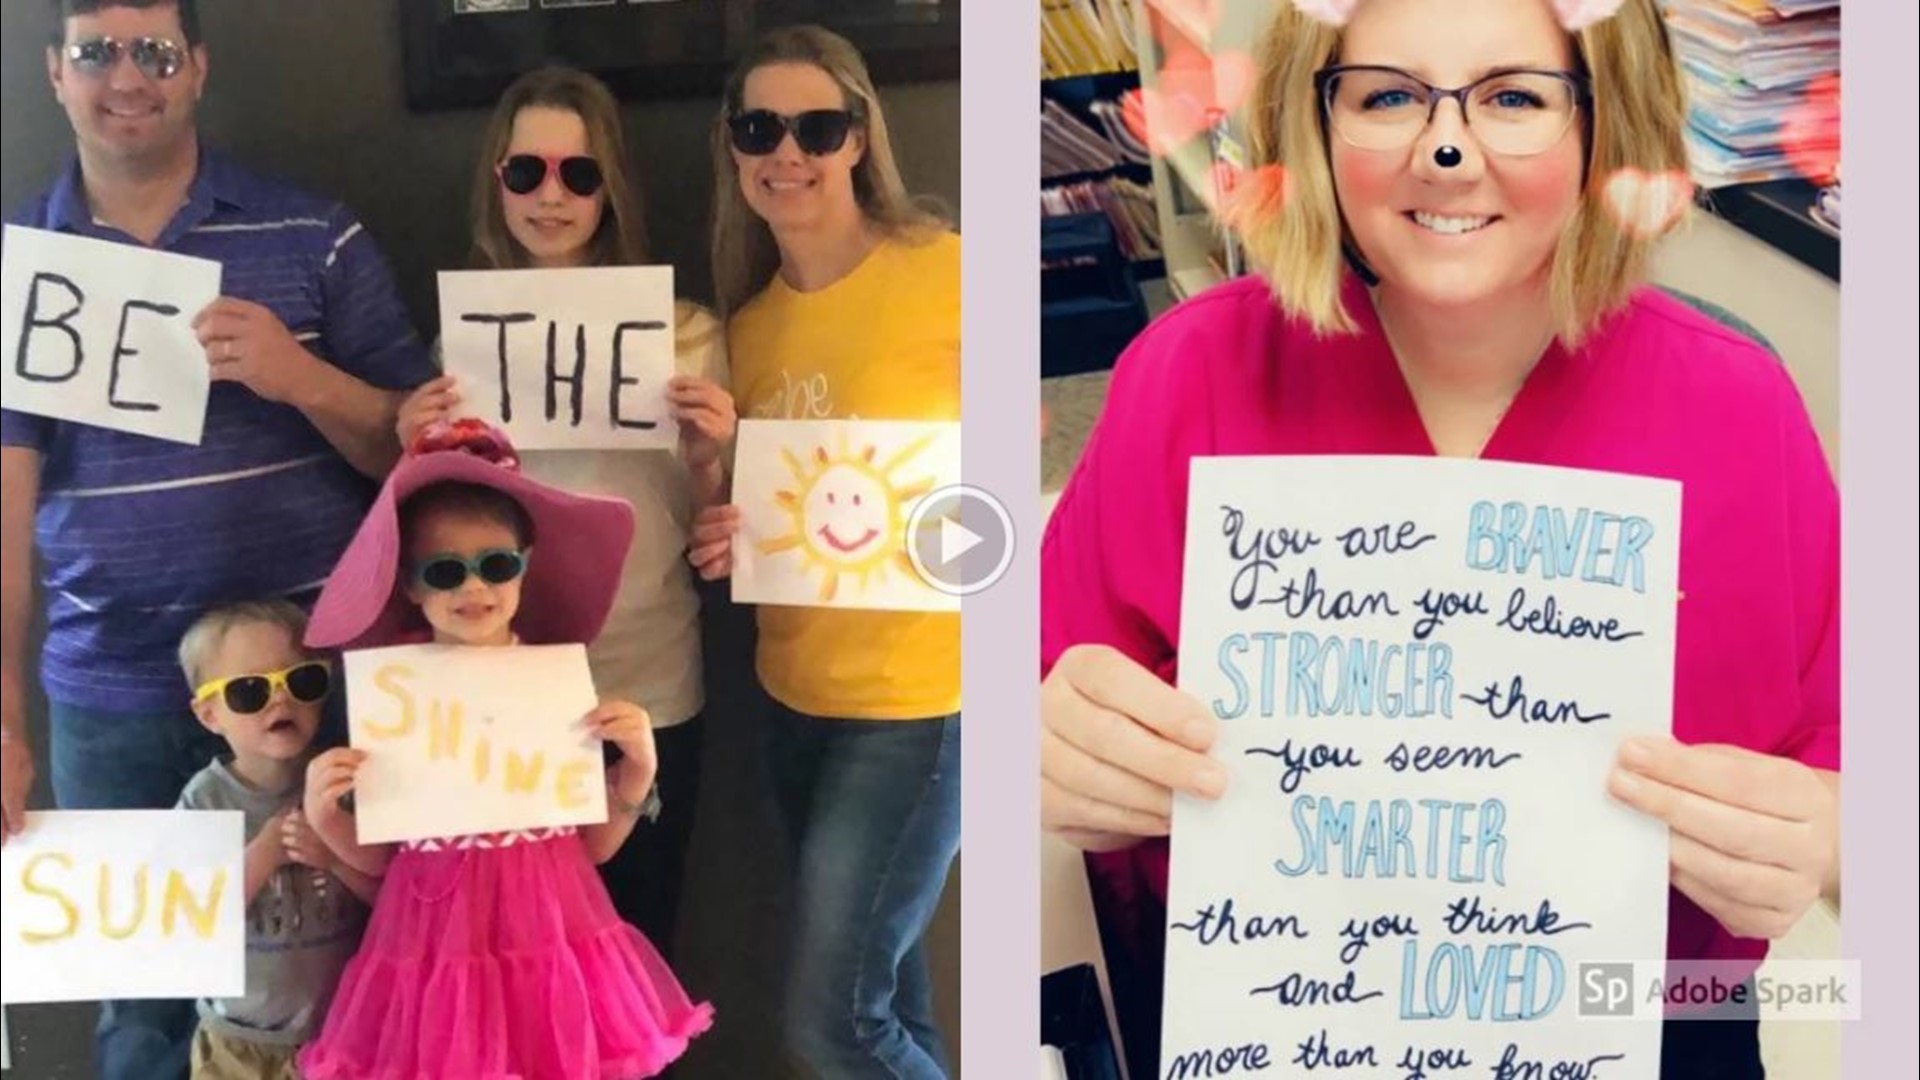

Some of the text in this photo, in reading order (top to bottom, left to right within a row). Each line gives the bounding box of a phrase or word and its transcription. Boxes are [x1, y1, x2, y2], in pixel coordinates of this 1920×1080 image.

[15, 272, 180, 411] BE
[461, 312, 666, 430] THE
[1220, 501, 1654, 610] You are BRAVER
[1258, 567, 1644, 641] than you believe
[1212, 631, 1610, 723] STRONGER than
[1245, 739, 1522, 793] you seem
[1274, 794, 1507, 886] SMARTER
[20, 851, 228, 945] SUN
[1170, 897, 1592, 963] than you think
[1250, 939, 1565, 1022] and LOVED
[1167, 1039, 1272, 1080] more
[1292, 1029, 1379, 1069] than
[1396, 1044, 1472, 1080] you
